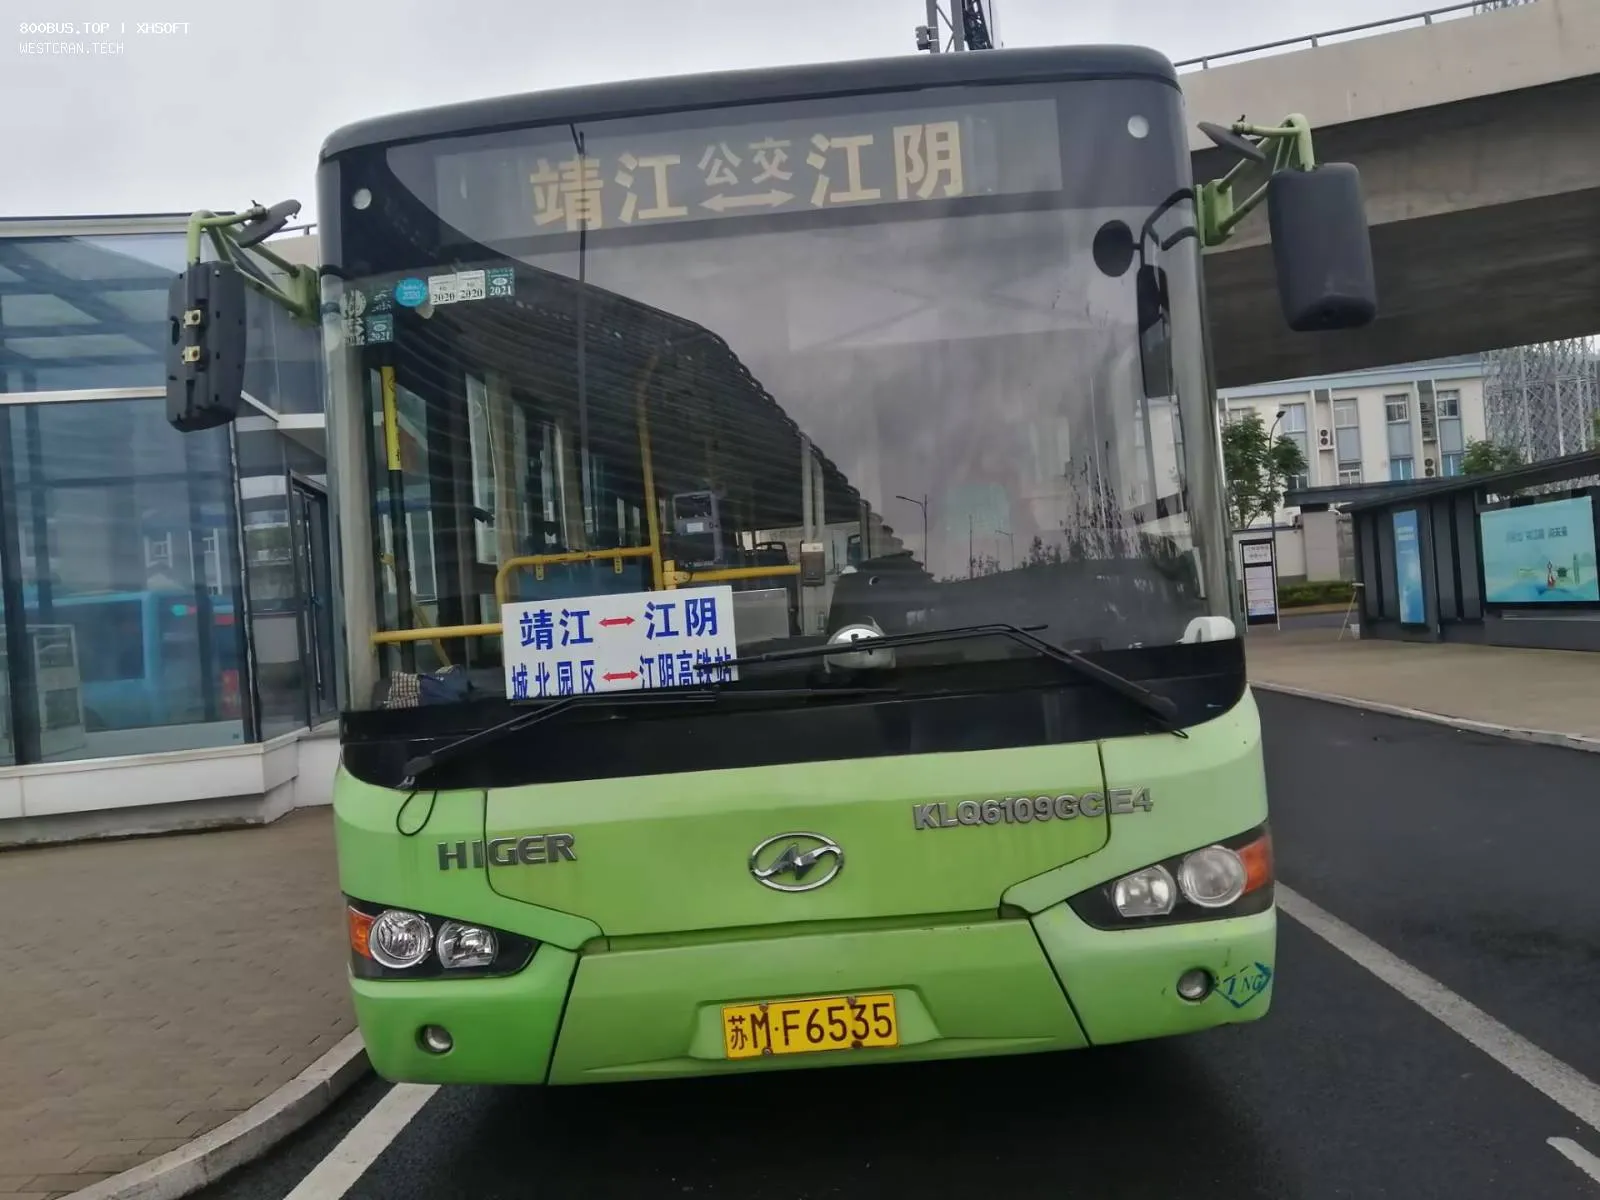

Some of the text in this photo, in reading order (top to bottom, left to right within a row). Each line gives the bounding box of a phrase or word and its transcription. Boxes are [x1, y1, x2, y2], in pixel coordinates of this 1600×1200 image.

[529, 121, 964, 231] 靖江 公交 江阴
[460, 288, 483, 299] 2020
[489, 286, 512, 296] 2021
[519, 597, 718, 650] 靖江 江阴
[511, 646, 733, 700] 城北园区 江阴高铁站
[437, 833, 577, 871] HIGER
